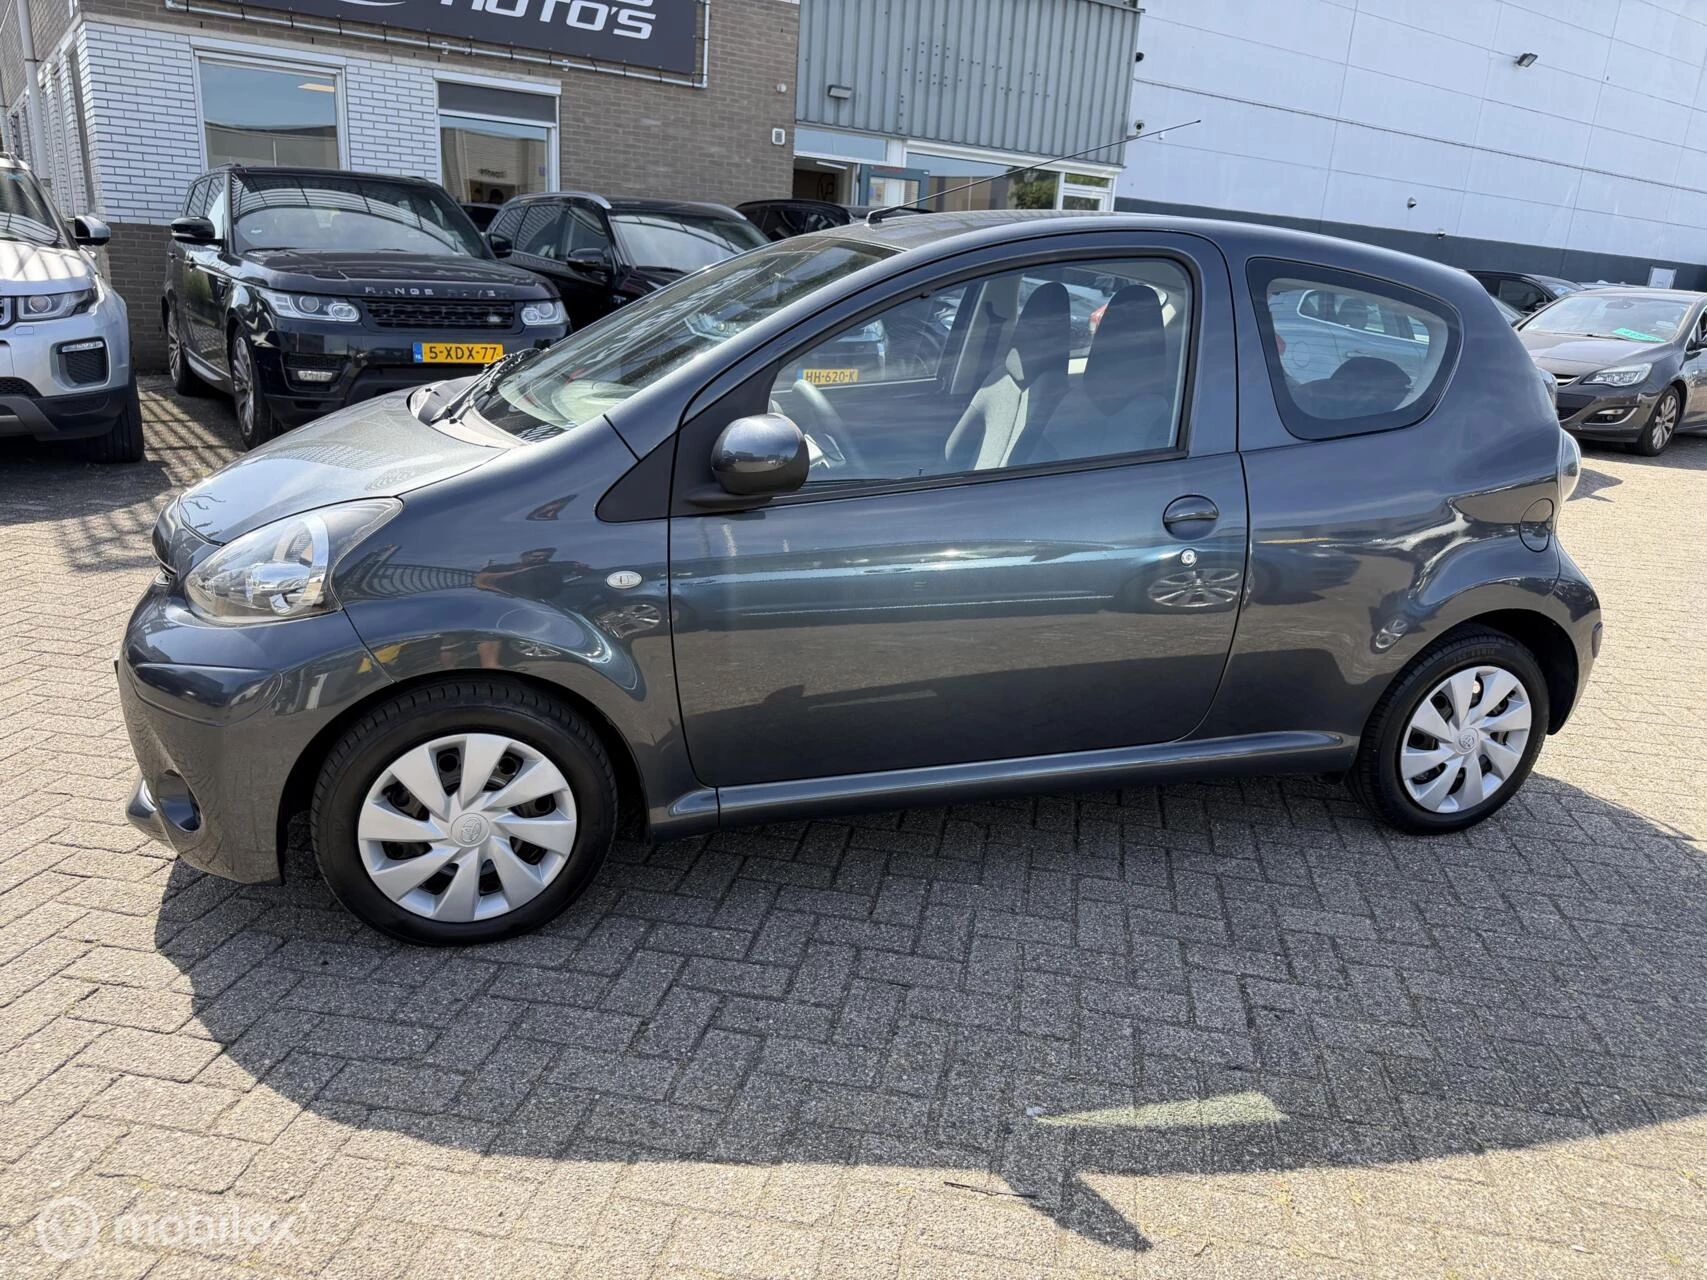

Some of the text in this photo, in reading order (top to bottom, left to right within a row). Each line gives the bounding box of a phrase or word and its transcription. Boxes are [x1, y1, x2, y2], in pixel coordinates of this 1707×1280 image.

[365, 286, 434, 296] RANGE
[429, 346, 497, 360] 5-XDX-77
[805, 370, 856, 383] HH-620-K
